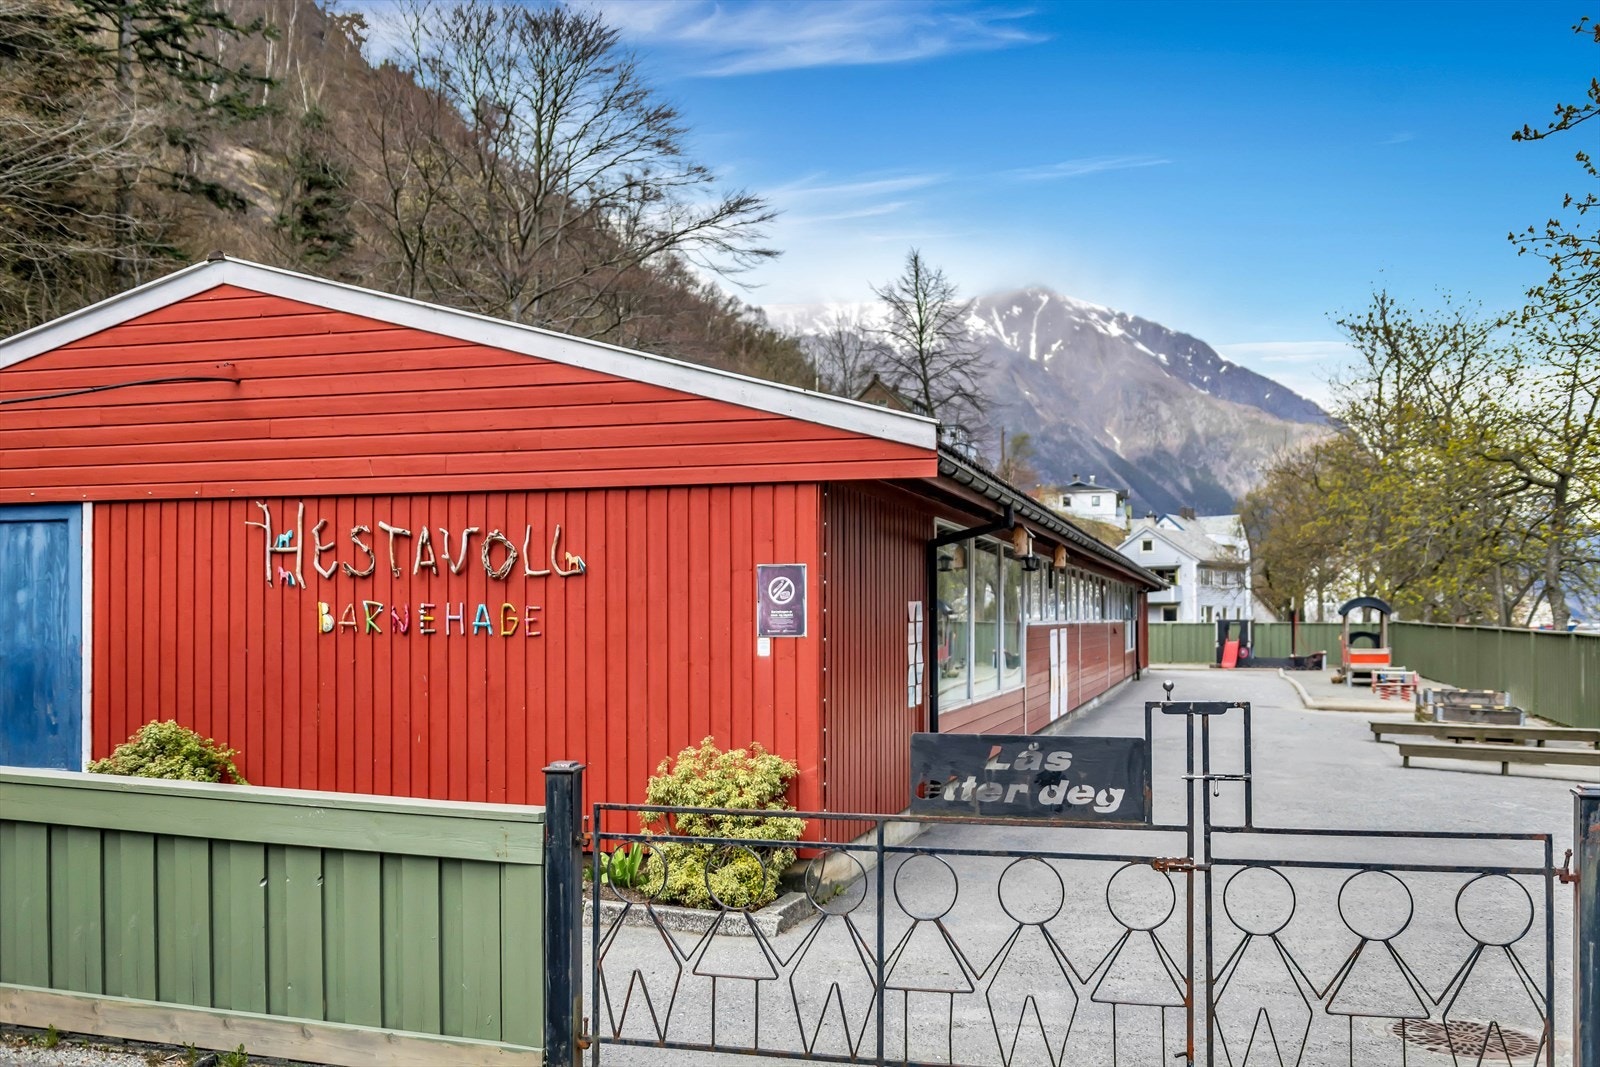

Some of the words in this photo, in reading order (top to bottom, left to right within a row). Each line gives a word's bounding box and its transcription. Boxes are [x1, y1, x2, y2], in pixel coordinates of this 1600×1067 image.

[246, 501, 586, 588] HESTAVOLL
[318, 600, 542, 636] BARNEHAGE
[984, 742, 1073, 771] Lås
[1038, 780, 1126, 814] deg
